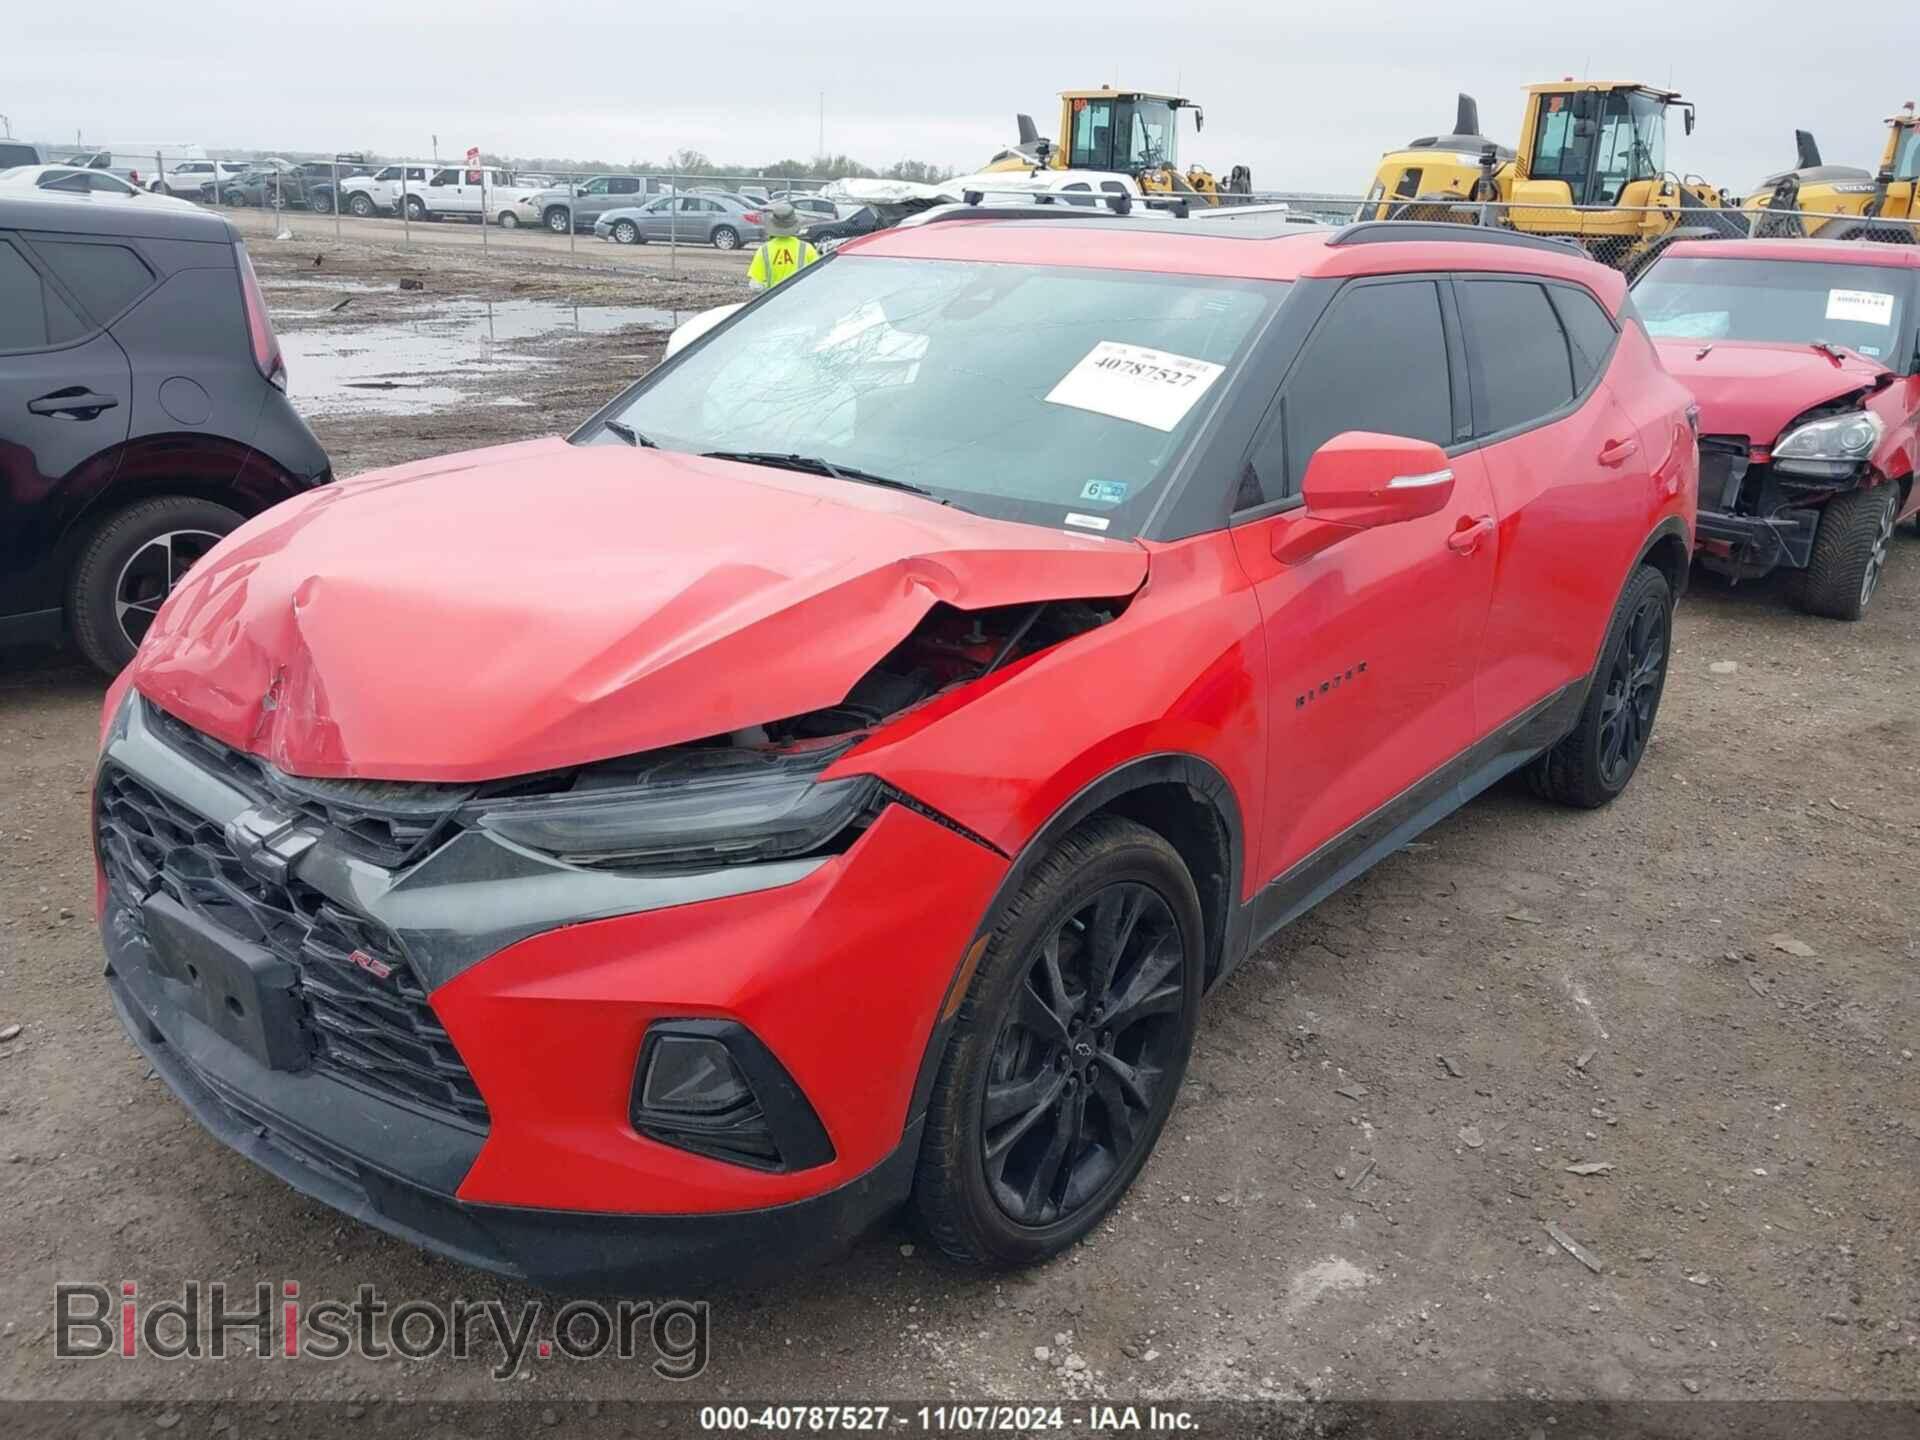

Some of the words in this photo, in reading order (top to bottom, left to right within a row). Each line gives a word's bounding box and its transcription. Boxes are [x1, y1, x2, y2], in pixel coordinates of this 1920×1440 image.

[1094, 357, 1197, 387] 40787527
[1088, 483, 1099, 496] 6
[349, 949, 393, 978] RS
